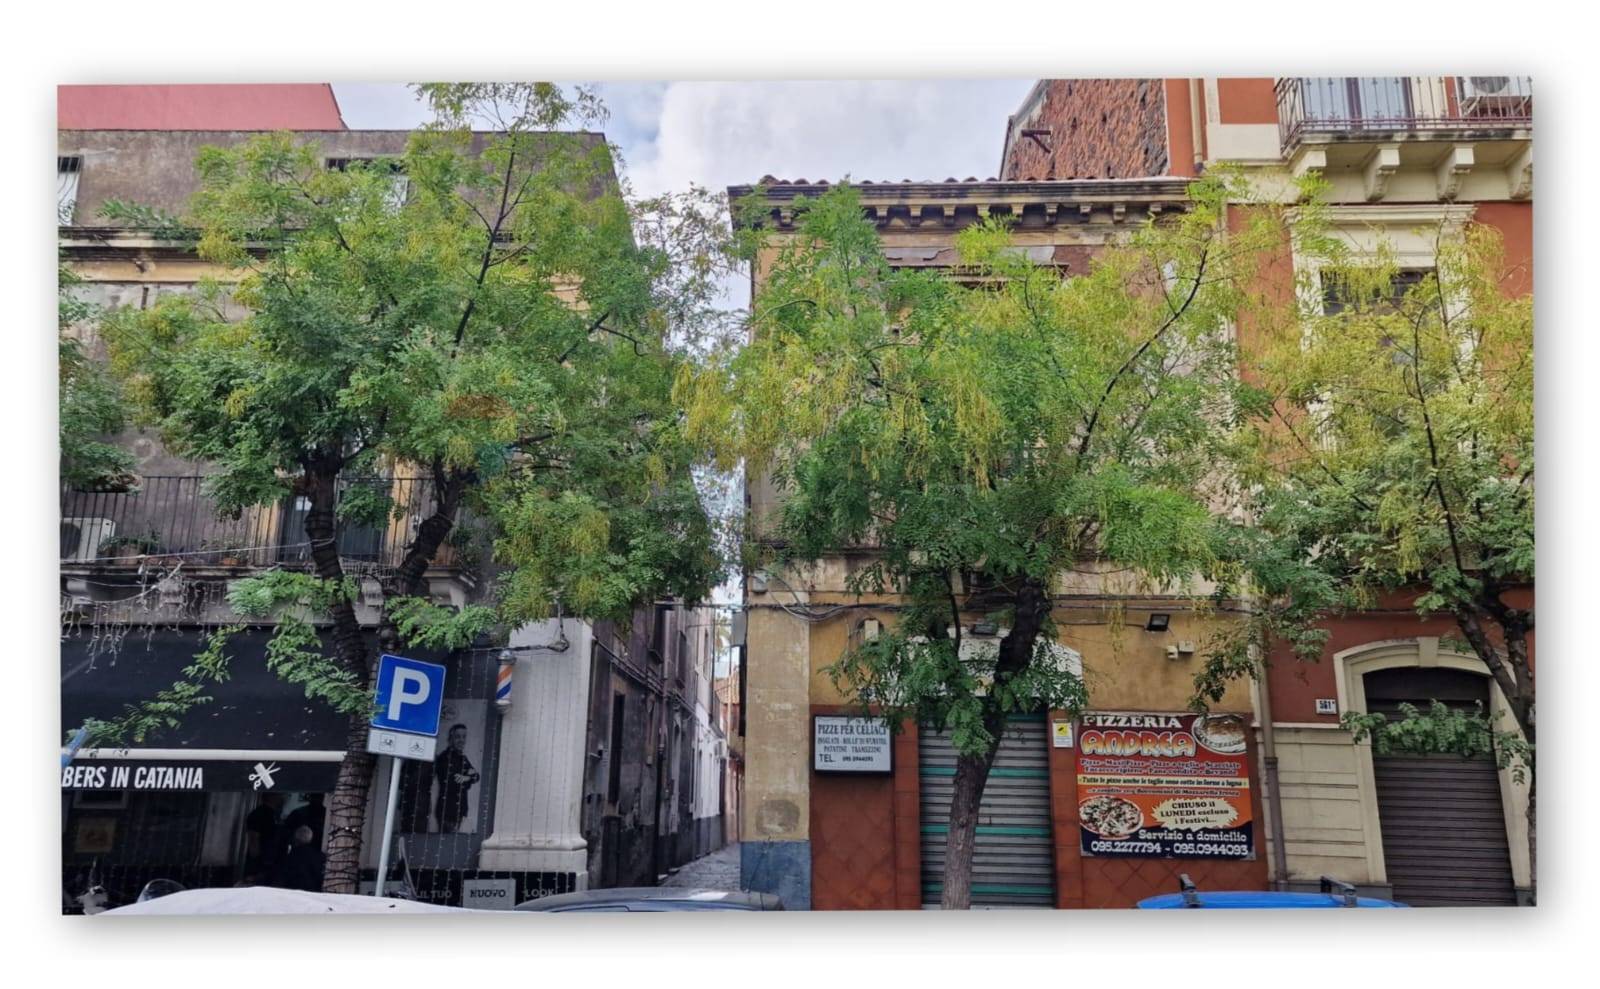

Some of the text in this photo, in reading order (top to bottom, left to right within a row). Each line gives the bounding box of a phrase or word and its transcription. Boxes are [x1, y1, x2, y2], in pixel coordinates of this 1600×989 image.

[387, 666, 430, 720] P
[1083, 714, 1183, 729] PIZZERIA
[817, 724, 839, 735] PIZZE
[840, 724, 855, 735] PER
[1080, 729, 1197, 758] ANDREA
[62, 766, 203, 789] BERS IN CATANIA
[1082, 776, 1099, 784] Tutte
[1171, 801, 1207, 810] CHIUSO
[1198, 808, 1230, 816] escluso
[1175, 817, 1179, 825] i
[1138, 829, 1248, 842] Servizio a domicilio
[1090, 840, 1249, 856] 095.2277794 095.0944093
[431, 889, 453, 899] TUO
[469, 889, 507, 898] NUOVO
[523, 888, 555, 899] LOOK
